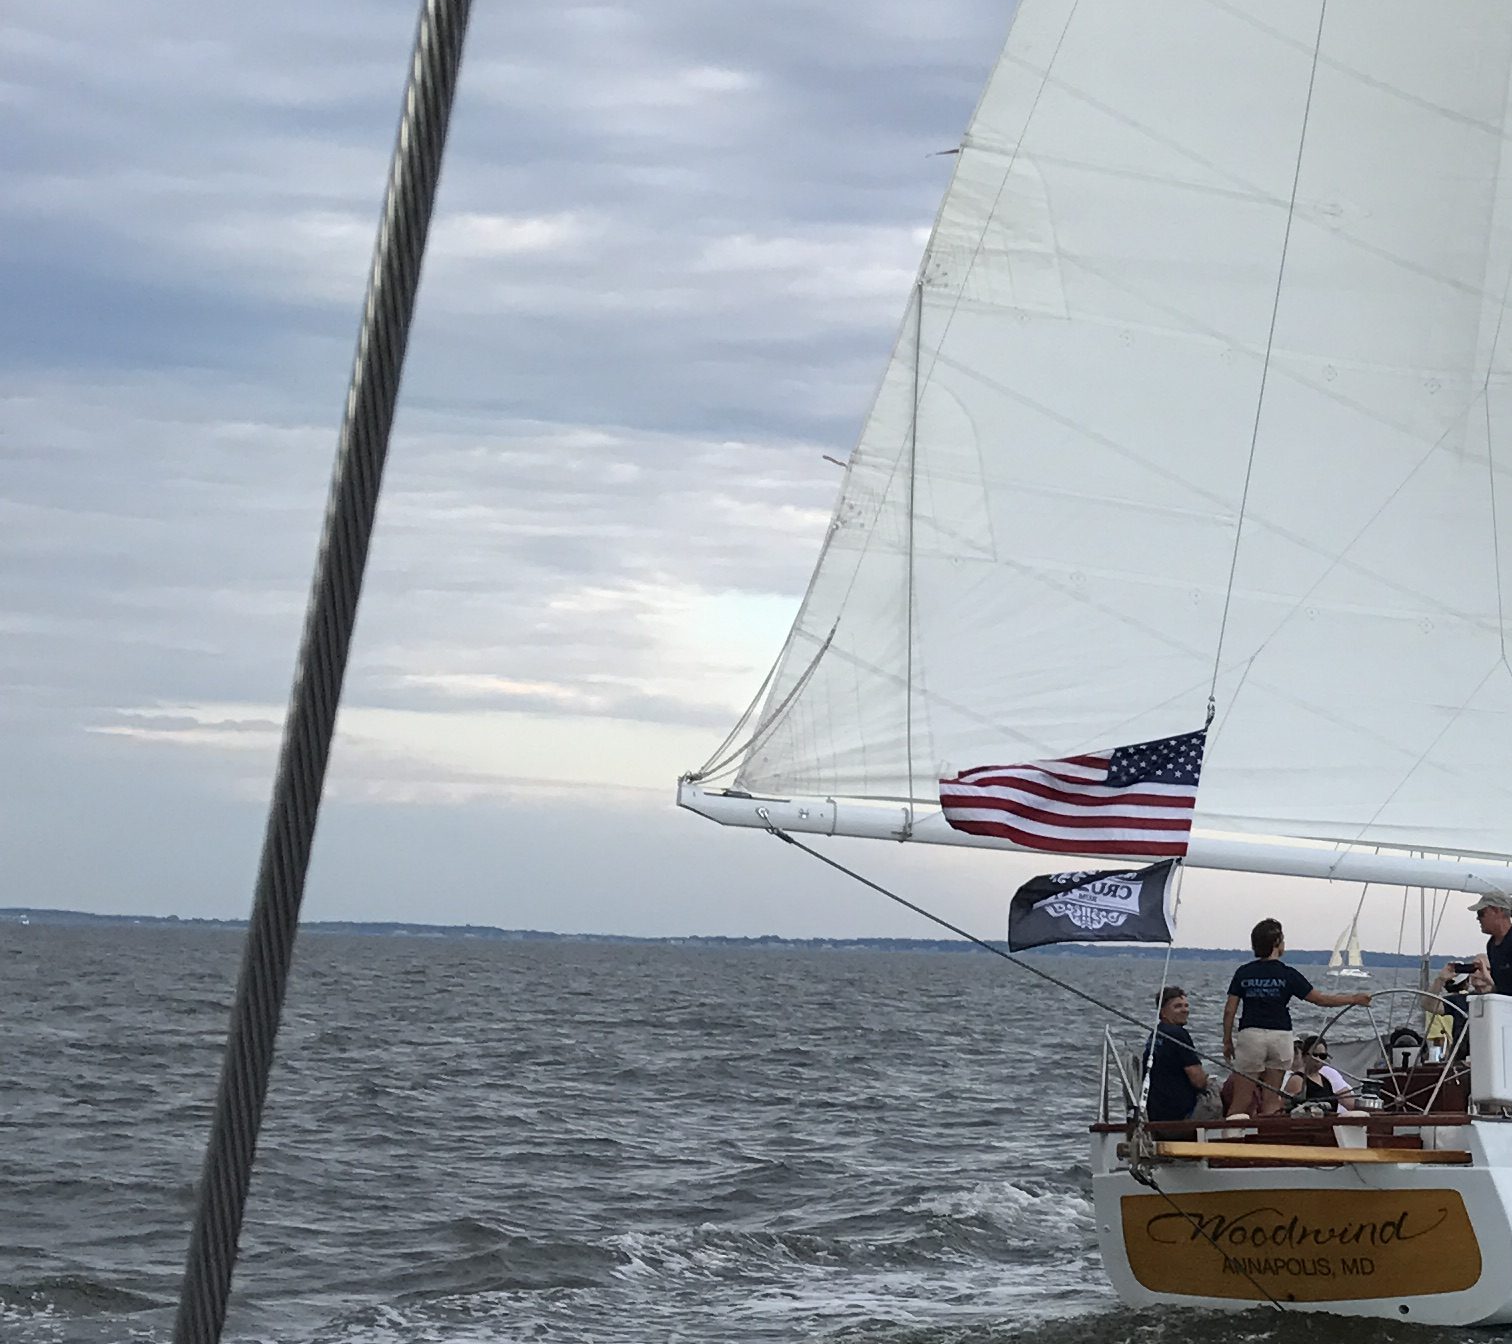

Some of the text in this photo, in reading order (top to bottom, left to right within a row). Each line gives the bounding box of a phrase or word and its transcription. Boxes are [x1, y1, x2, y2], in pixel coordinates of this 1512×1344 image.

[1241, 978, 1287, 988] CRUZAN
[1147, 1207, 1447, 1247] Woodwind
[1222, 1257, 1376, 1279] ANNAPOLIS, MD
